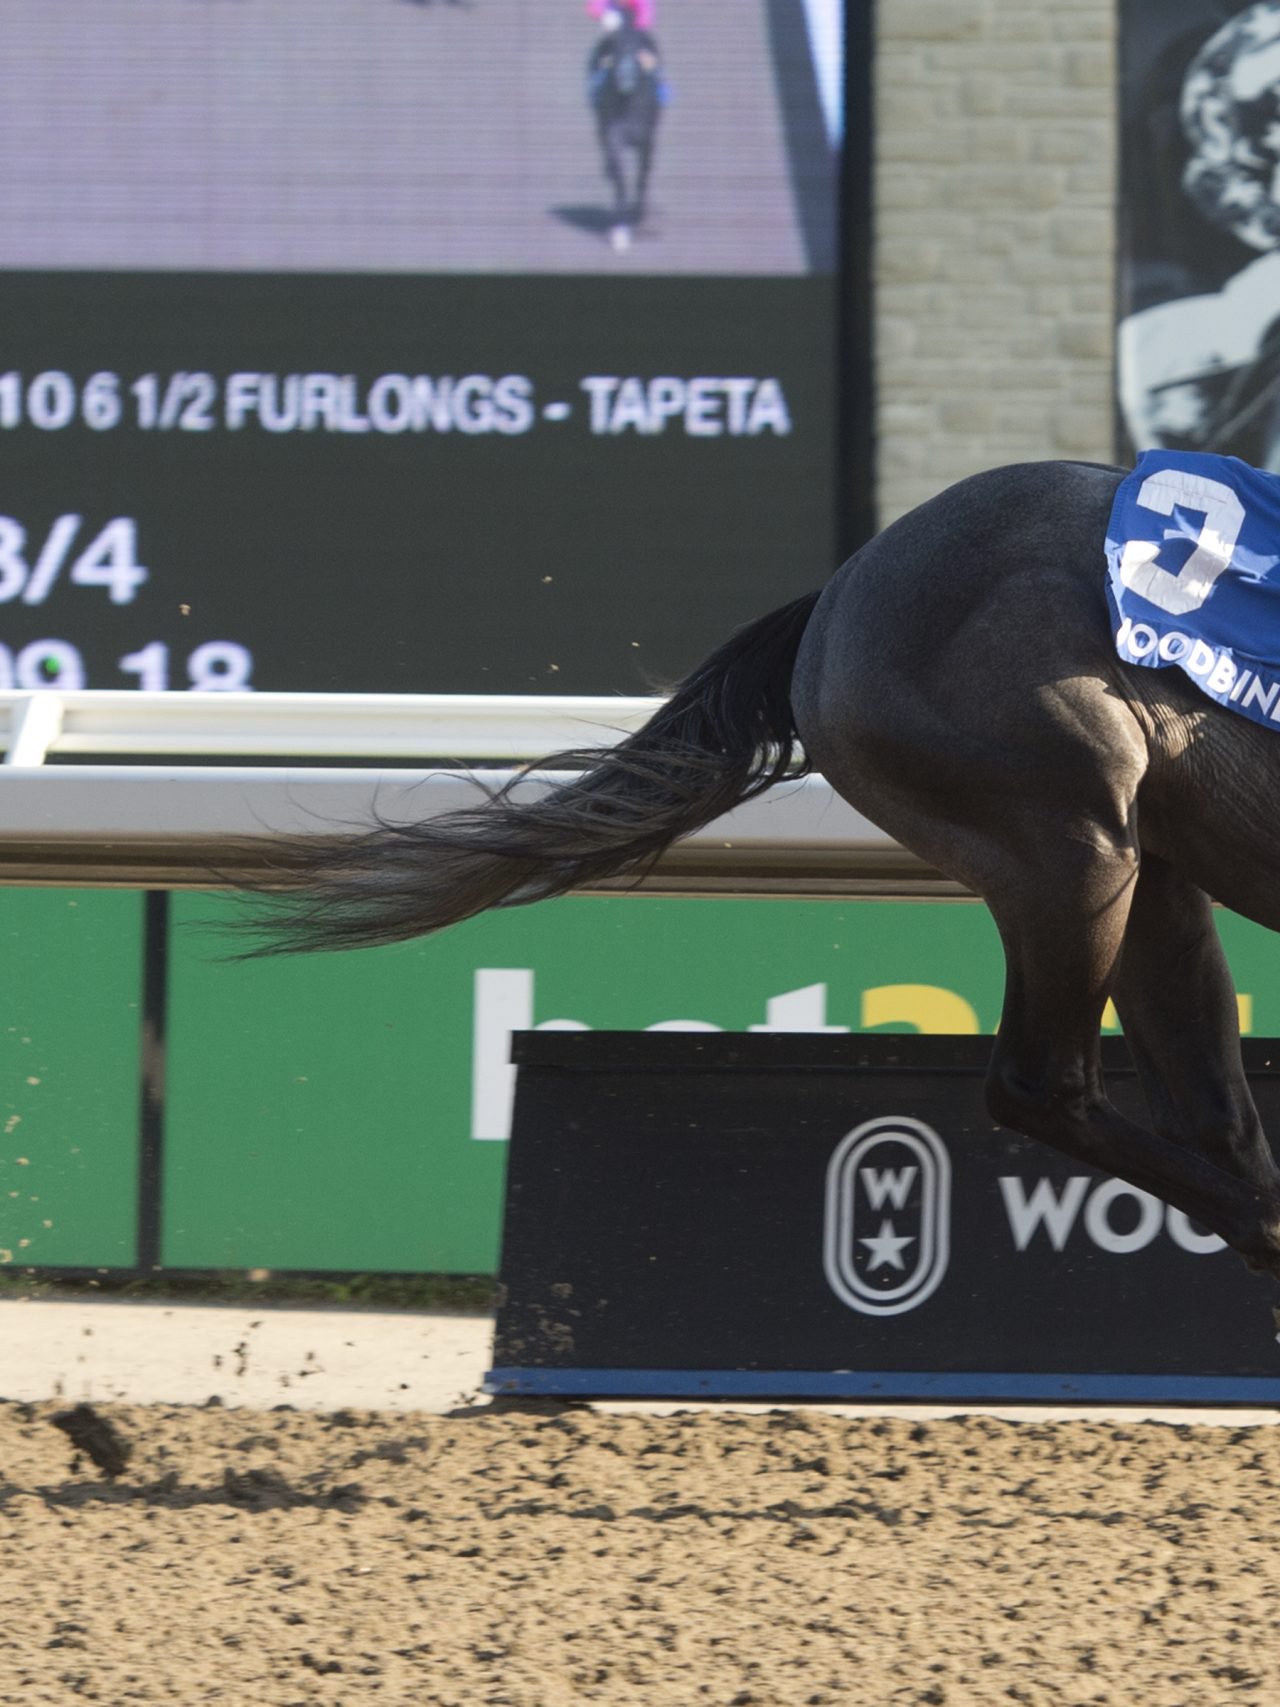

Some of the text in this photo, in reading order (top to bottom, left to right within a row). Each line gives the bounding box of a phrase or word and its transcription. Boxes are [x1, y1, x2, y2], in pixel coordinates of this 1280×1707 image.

[82, 370, 122, 432] 6
[130, 371, 217, 432] 1/2
[226, 373, 534, 435] FURLONGS
[581, 377, 793, 437] TAPETA
[1119, 468, 1246, 616] 3
[860, 1167, 918, 1210] W
